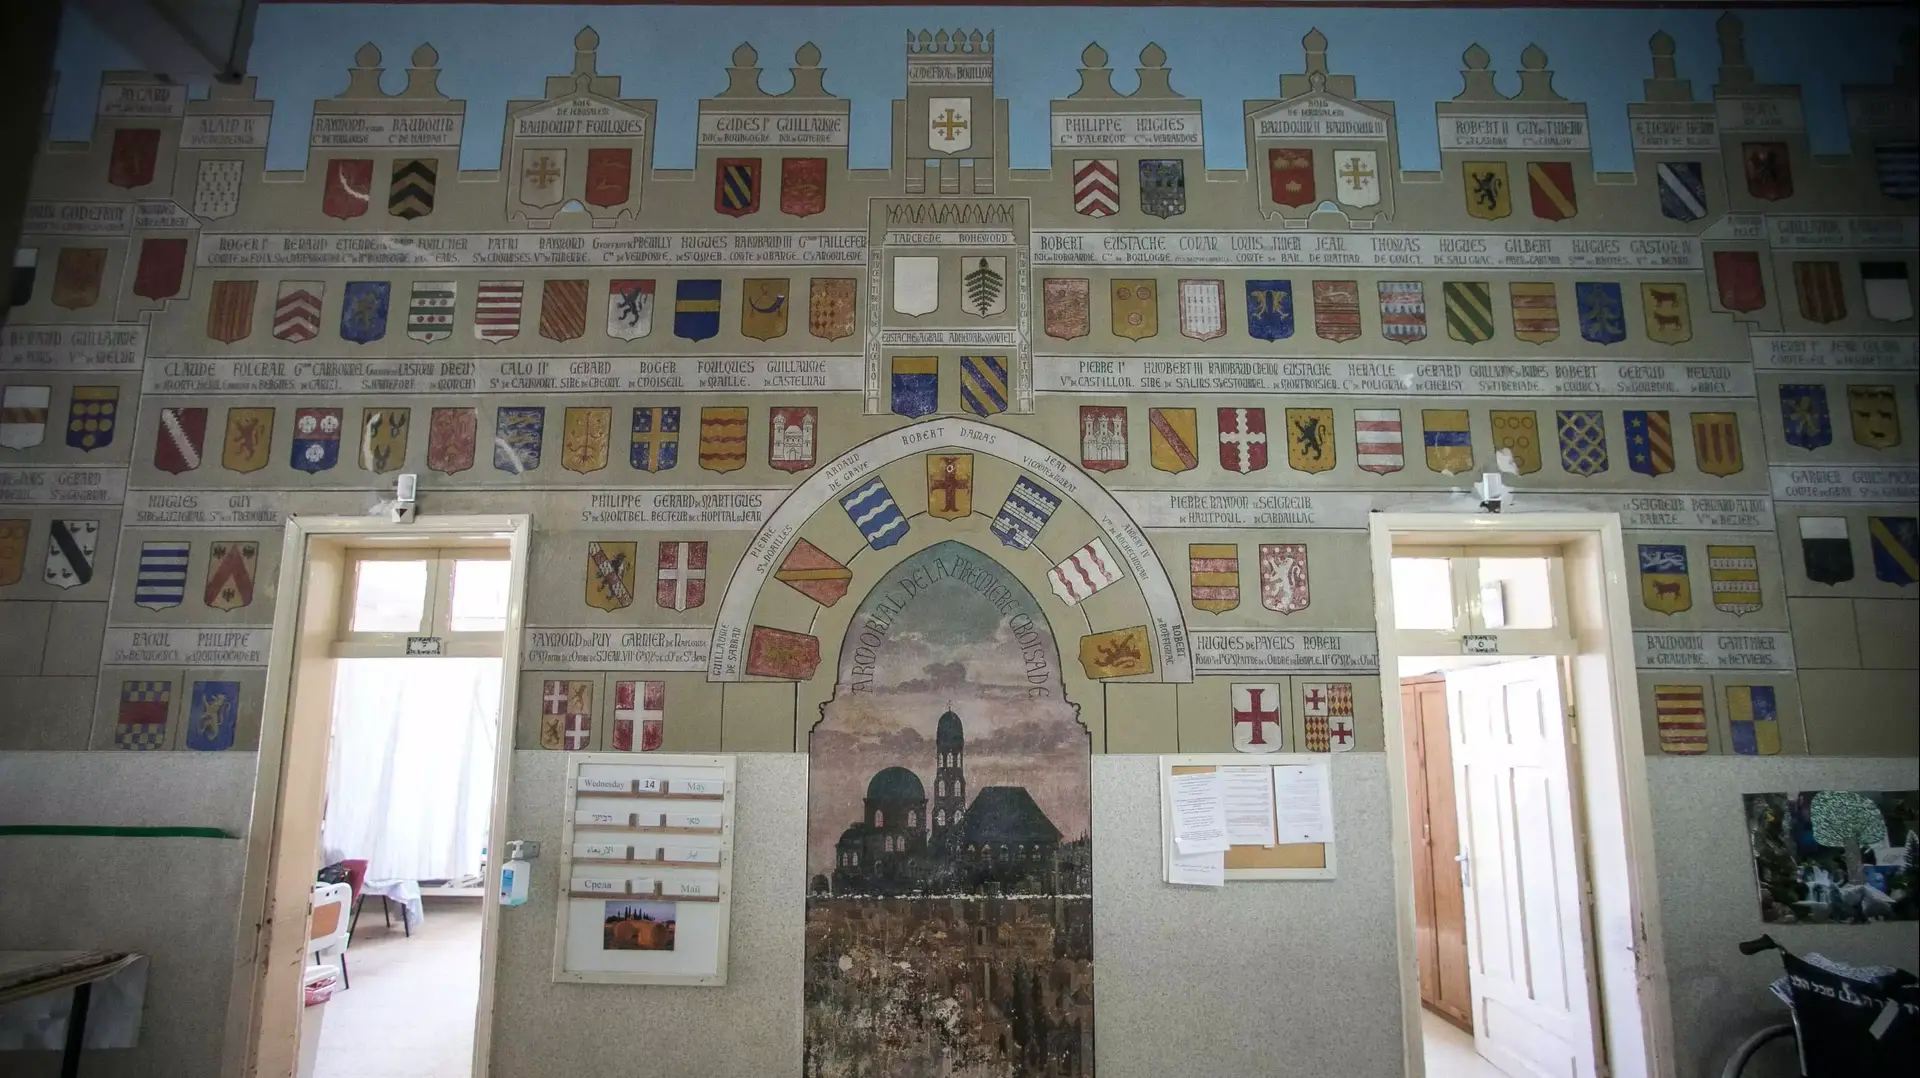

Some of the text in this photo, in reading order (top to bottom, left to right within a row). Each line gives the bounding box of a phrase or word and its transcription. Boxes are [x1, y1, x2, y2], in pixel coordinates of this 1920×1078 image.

[586, 119, 642, 133] FOULQUES
[717, 117, 841, 131] EUDES GUILLAUME
[1065, 117, 1184, 132] PHILIPPE HUGUES
[1455, 121, 1500, 135] ROBERT
[219, 238, 260, 251] ROGER
[539, 237, 585, 250] RAYMOND
[633, 236, 673, 249] PREUILLY
[681, 236, 728, 249] HUGUES
[817, 236, 867, 249] TAILLEFER
[893, 233, 1008, 243] TANCREDE BOHEMOND
[1041, 236, 1084, 250] ROBERT
[1104, 236, 1166, 251] EUSTACHE
[1231, 236, 1263, 251] LOUIS
[1315, 236, 1347, 250] JEAN
[1371, 237, 1421, 252] THOMAS
[1440, 238, 1487, 252] HUGUES
[1504, 238, 1552, 253] GILBERT
[1572, 239, 1620, 253] HUGUES
[164, 362, 216, 377] CLAUDE
[500, 361, 533, 376] CALO
[569, 360, 612, 375] GERARD
[640, 361, 677, 374] ROGER
[697, 360, 755, 374] FOULQUES
[767, 360, 827, 374] GUILLAUME
[1079, 361, 1114, 374] PIERRE
[1143, 361, 1191, 374] HUMBERT
[1282, 362, 1332, 376] EUSTACHE
[1348, 363, 1395, 377] HERACLE
[1416, 364, 1462, 377] GERARD
[1554, 365, 1598, 379] ROBERT
[1618, 366, 1666, 380] GERAUD
[772, 375, 827, 387] CASTELNAU
[1140, 377, 1161, 388] SIRE
[901, 427, 997, 446] ROBERT DAMAS
[825, 453, 861, 480] ARNAUD
[1044, 455, 1067, 473] JEAN
[828, 460, 870, 492] DE GRAVE
[148, 495, 252, 508] HUGUES GUY
[591, 493, 762, 509] PHILIPPE GERARD MARTIGUES
[1170, 496, 1207, 509] PIERRE
[1258, 496, 1313, 509] SEIGNEUR
[1631, 498, 1686, 511] SEIGNEUR
[651, 510, 688, 522] RECTEUR
[1260, 511, 1315, 524] CARDAILLAC
[750, 526, 777, 559] PIERRE
[851, 554, 1051, 700] ARMORIAL DE LA PREMIERE CROISADE
[132, 632, 251, 647] RAOUL PHILIPPE
[532, 632, 666, 647] RAYMOND PUY GARNIER
[1171, 624, 1187, 658] ROBERT
[1197, 636, 1245, 650] HUGUES
[1255, 636, 1295, 650] PAYENS
[1303, 636, 1342, 650] ROBERT
[1646, 635, 1704, 650] BAUDOUIN
[712, 624, 730, 677] GUILLAUME
[725, 627, 742, 675] DE SABRAN
[584, 779, 706, 794] Wednesday 14 May
